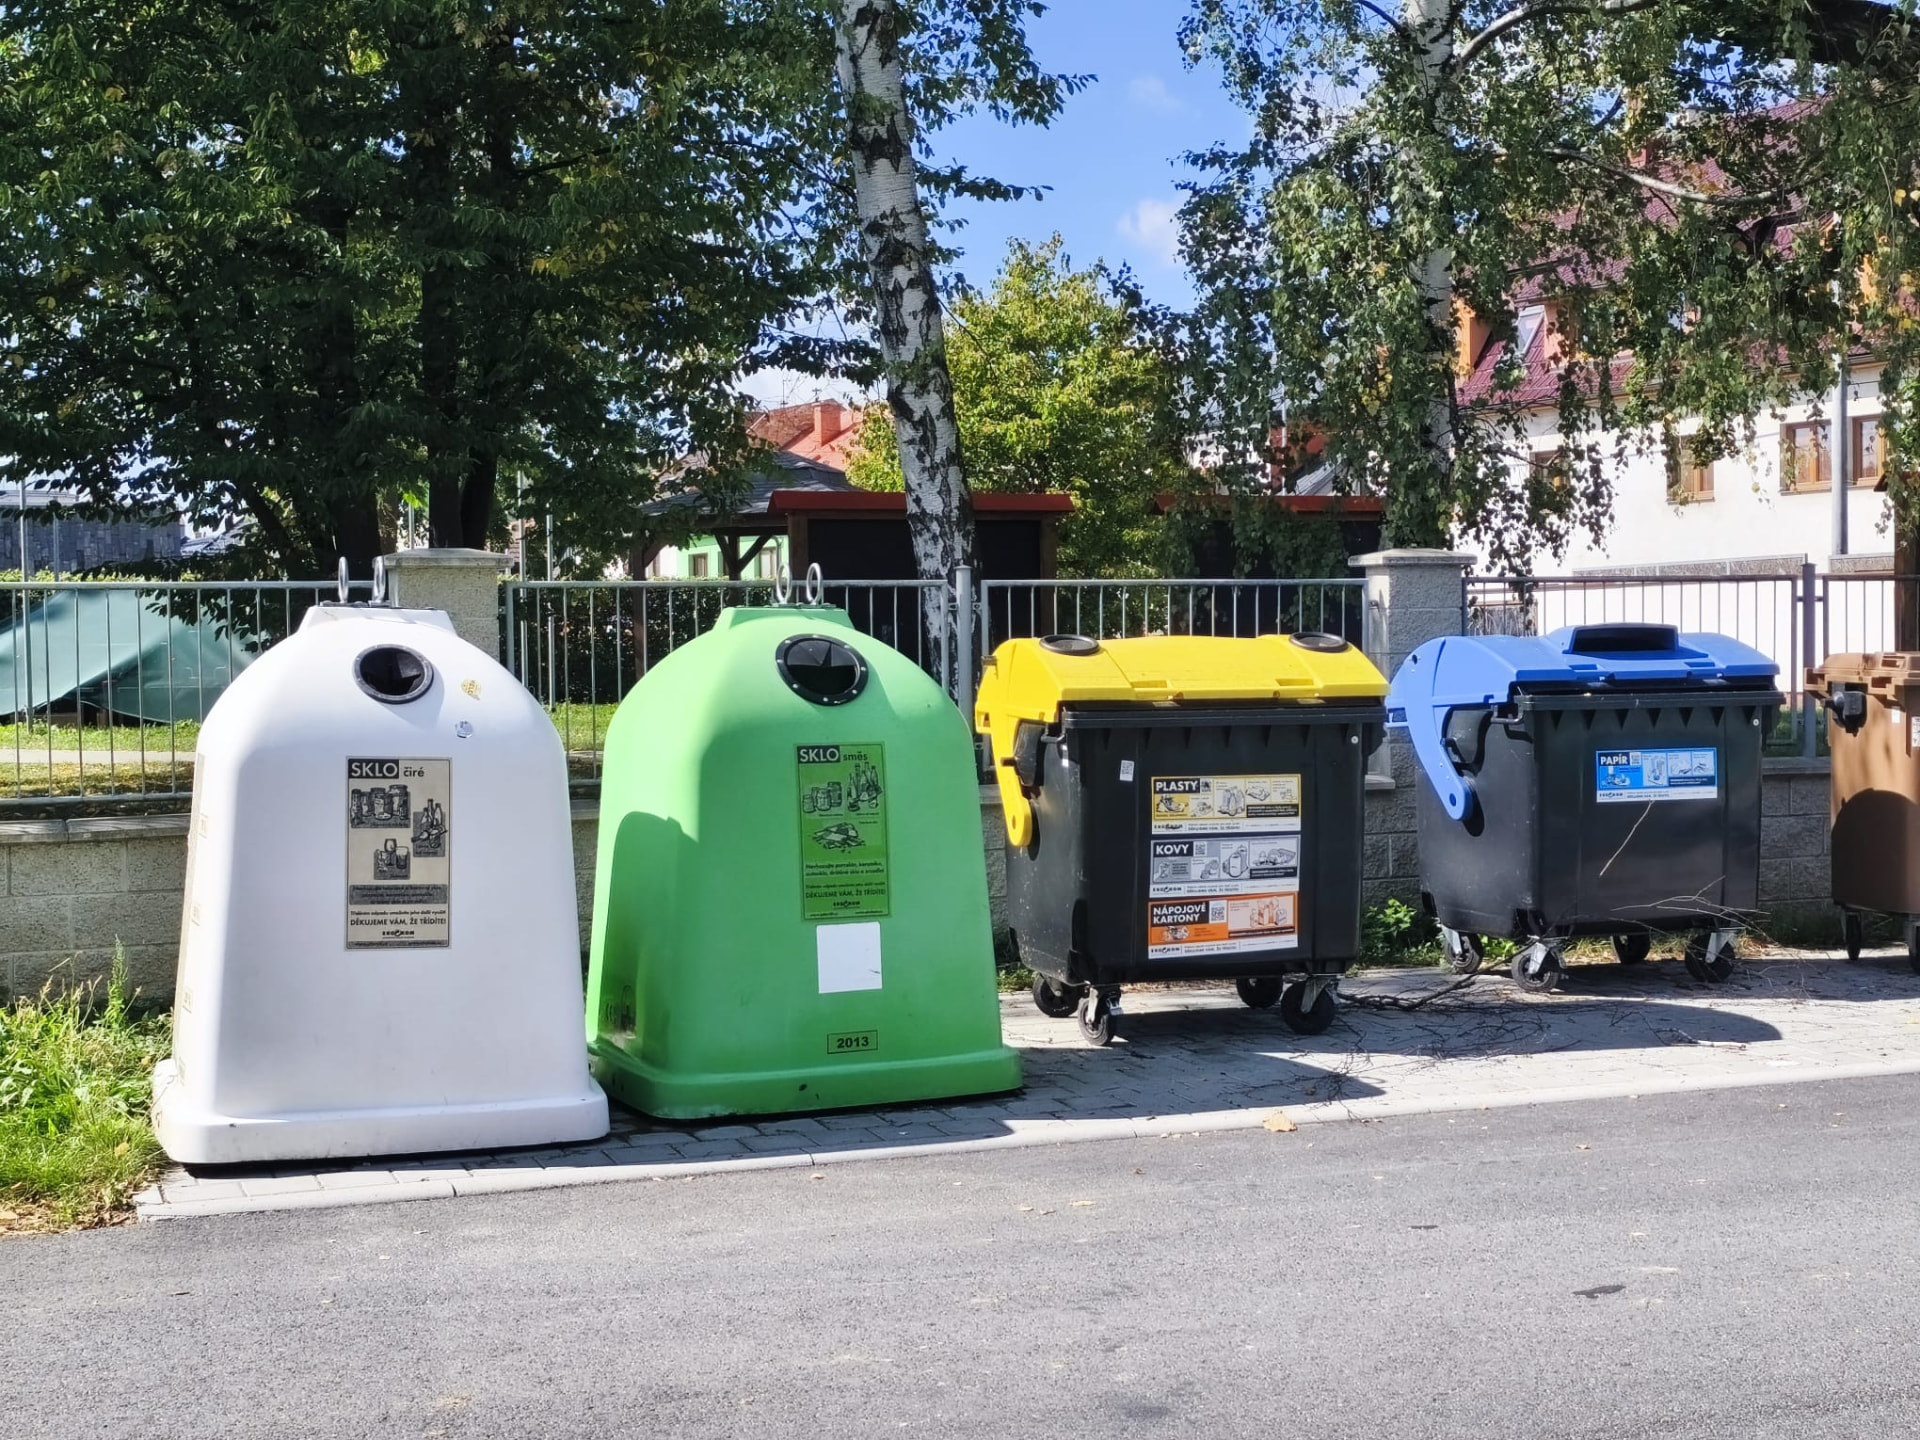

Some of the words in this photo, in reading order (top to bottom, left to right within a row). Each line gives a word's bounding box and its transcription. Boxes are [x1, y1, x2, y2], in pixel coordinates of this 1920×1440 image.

[800, 748, 839, 762] SKLO
[843, 751, 868, 761] směs
[1600, 753, 1628, 765] PAPÍR
[351, 762, 398, 777] SKLO
[403, 766, 425, 777] čiré
[1155, 780, 1198, 792] PLASTY
[1155, 844, 1190, 855] KOVY
[1153, 901, 1207, 916] NÁPOJOVÉ
[350, 917, 387, 926] DĚKUJEME
[389, 917, 408, 926] VÁM,
[409, 916, 418, 925] ŽE
[1153, 913, 1200, 925] KARTONY
[837, 1036, 869, 1049] 2013
